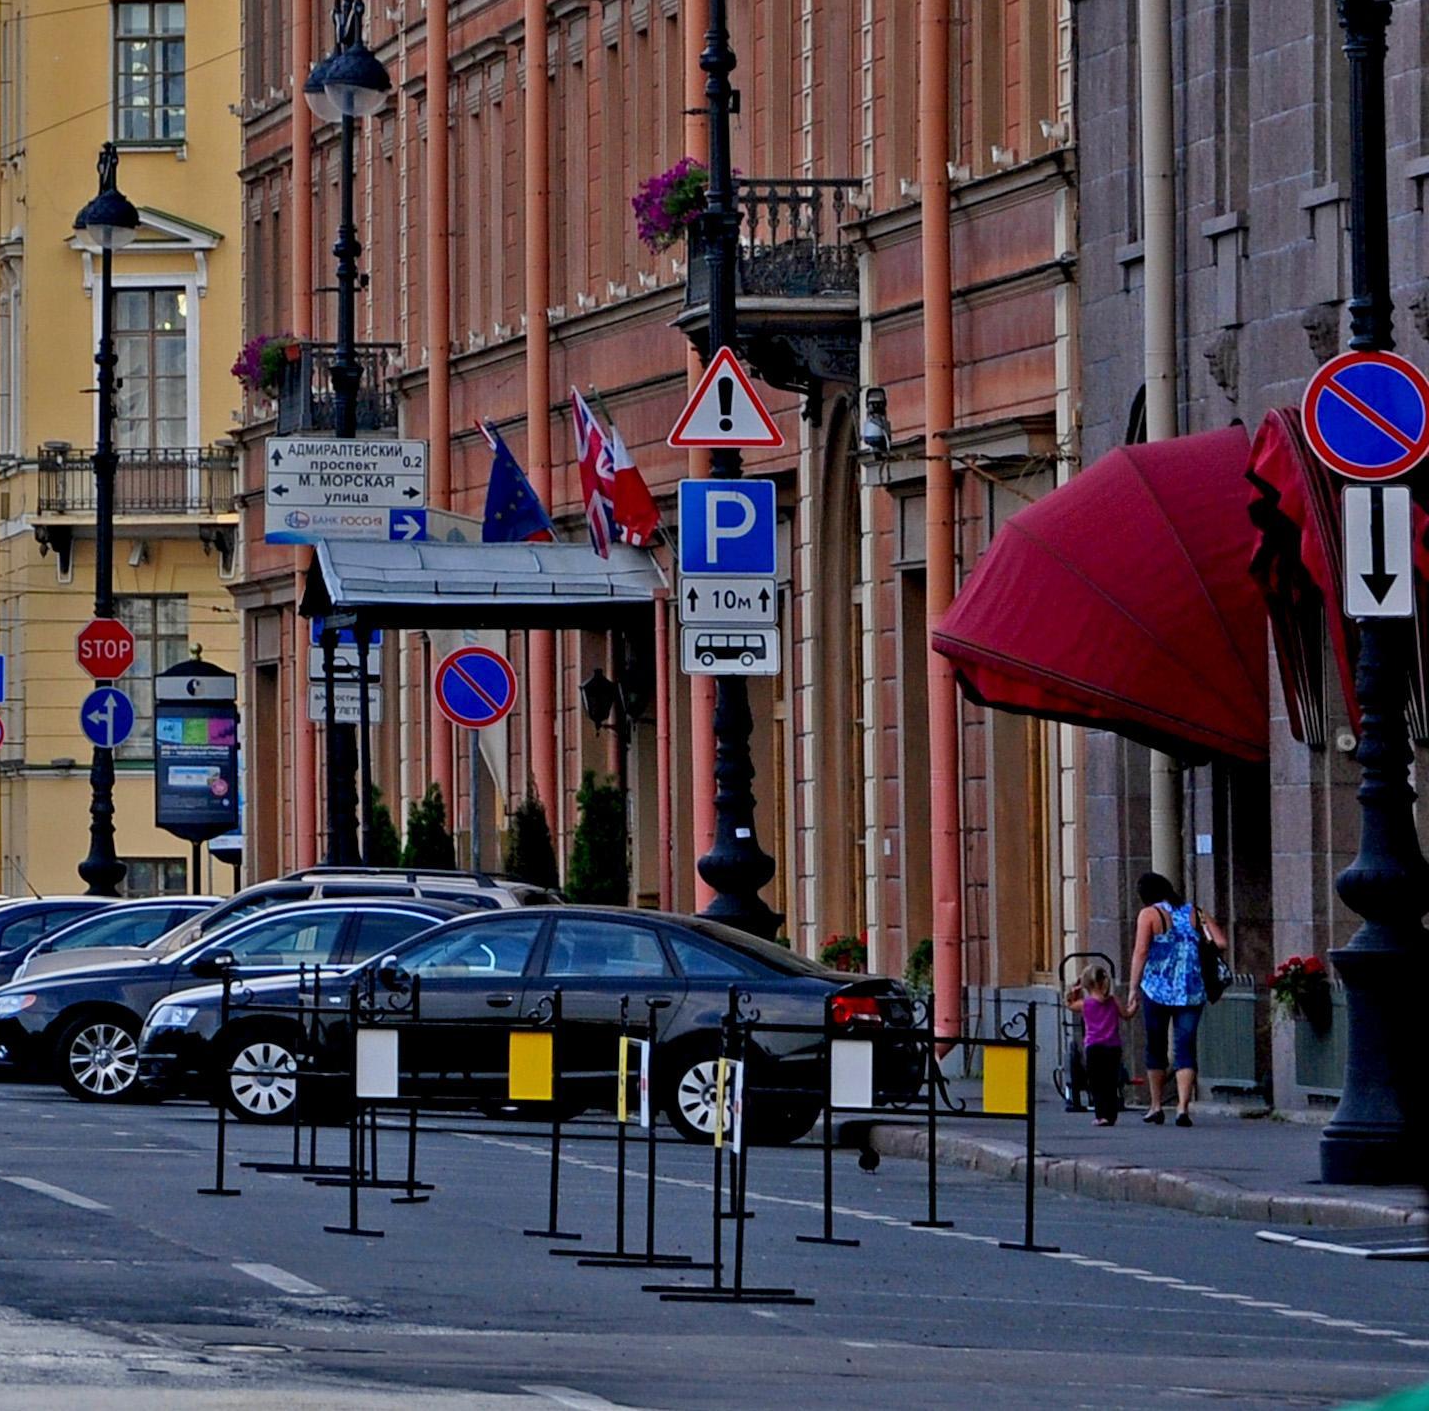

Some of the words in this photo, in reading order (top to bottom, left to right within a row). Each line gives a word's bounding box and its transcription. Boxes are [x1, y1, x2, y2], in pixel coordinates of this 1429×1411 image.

[287, 442, 403, 458] АДМИРАЛТЕЙСКИЙ
[309, 460, 379, 472] проспект
[402, 456, 422, 468] 0.2
[298, 474, 315, 487] М.
[319, 474, 395, 488] МОРСКАЯ
[324, 492, 369, 505] улица
[340, 515, 382, 526] РОССИЯ
[705, 490, 757, 564] P
[82, 639, 130, 660] STOP
